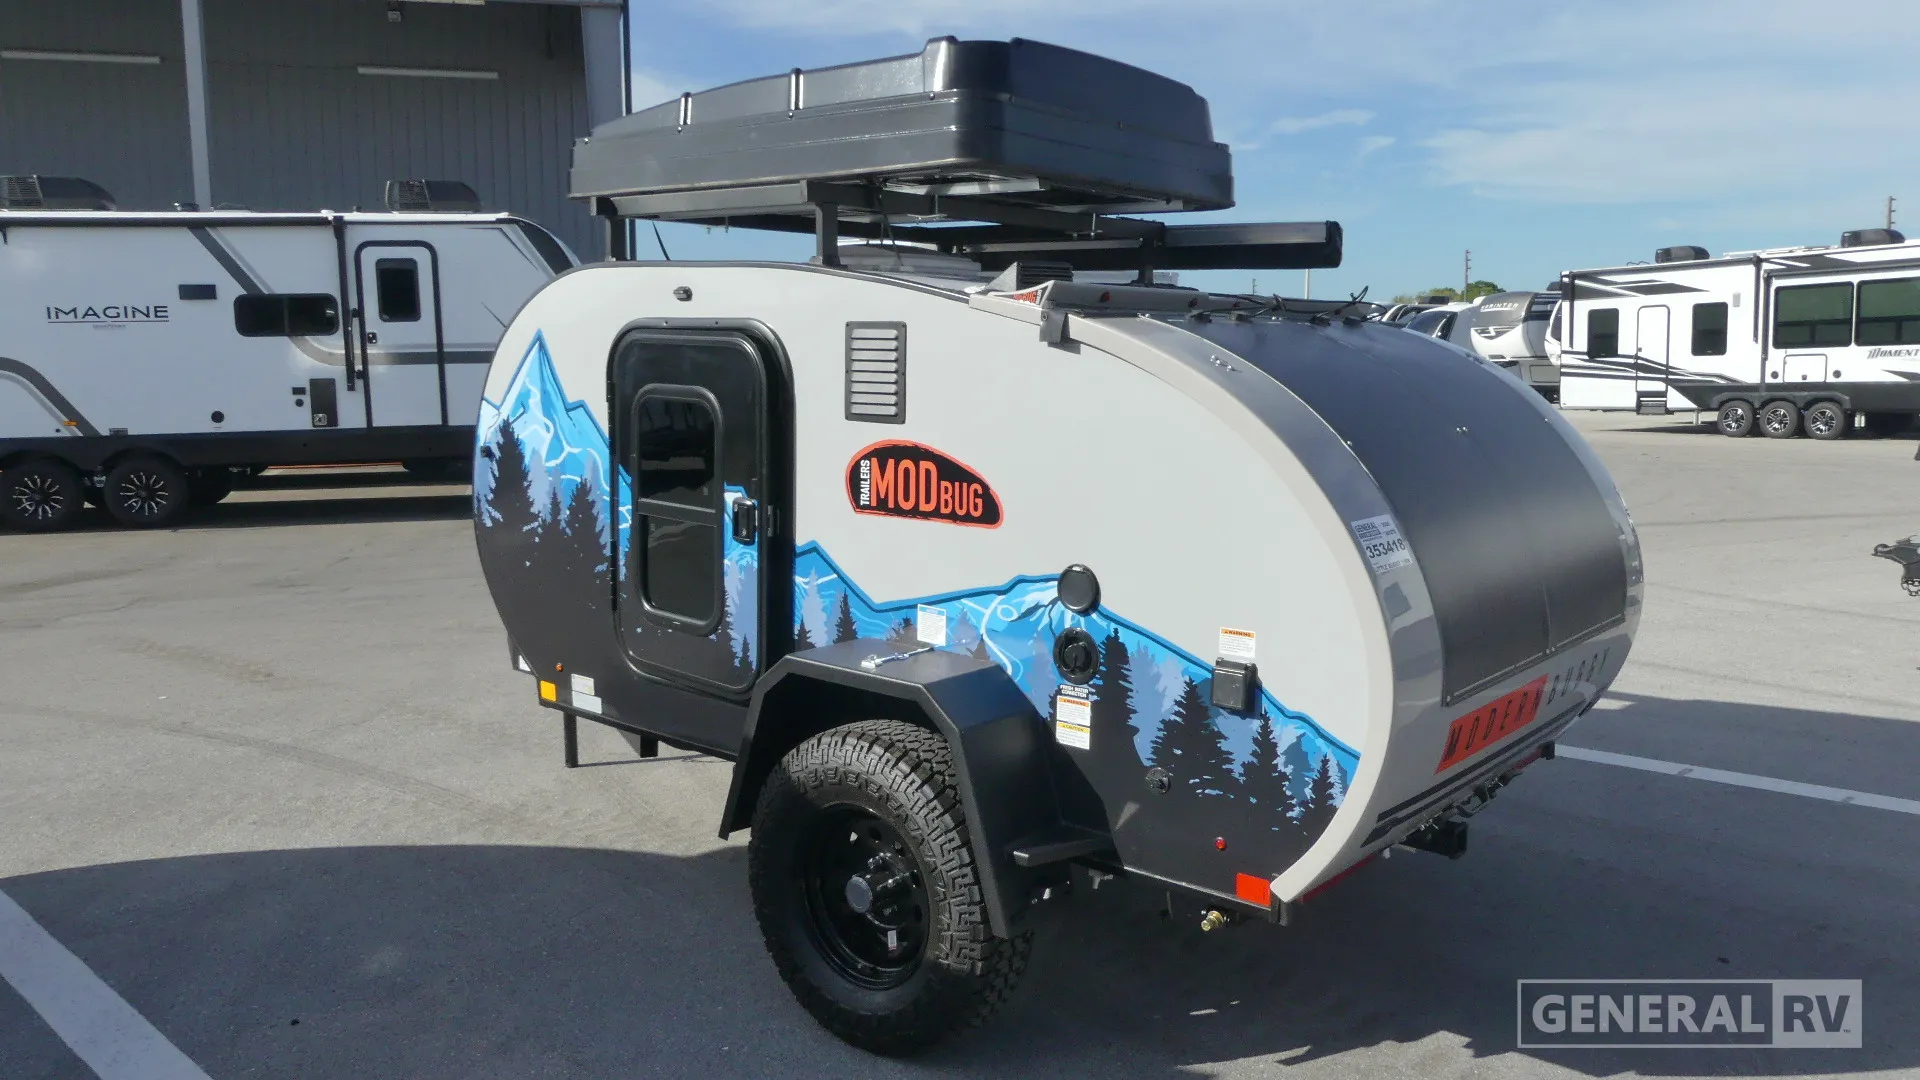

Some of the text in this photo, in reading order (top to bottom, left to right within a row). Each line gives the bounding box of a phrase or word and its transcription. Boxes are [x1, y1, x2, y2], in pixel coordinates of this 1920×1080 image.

[46, 305, 169, 320] IMAGINE
[1481, 302, 1519, 310] SPRINTER
[860, 459, 870, 506] TRAILERS
[1354, 521, 1378, 533] GENERAL
[1365, 538, 1406, 559] 353418
[1228, 629, 1251, 637] WARNING
[1443, 646, 1611, 762] MODERN BUGGY
